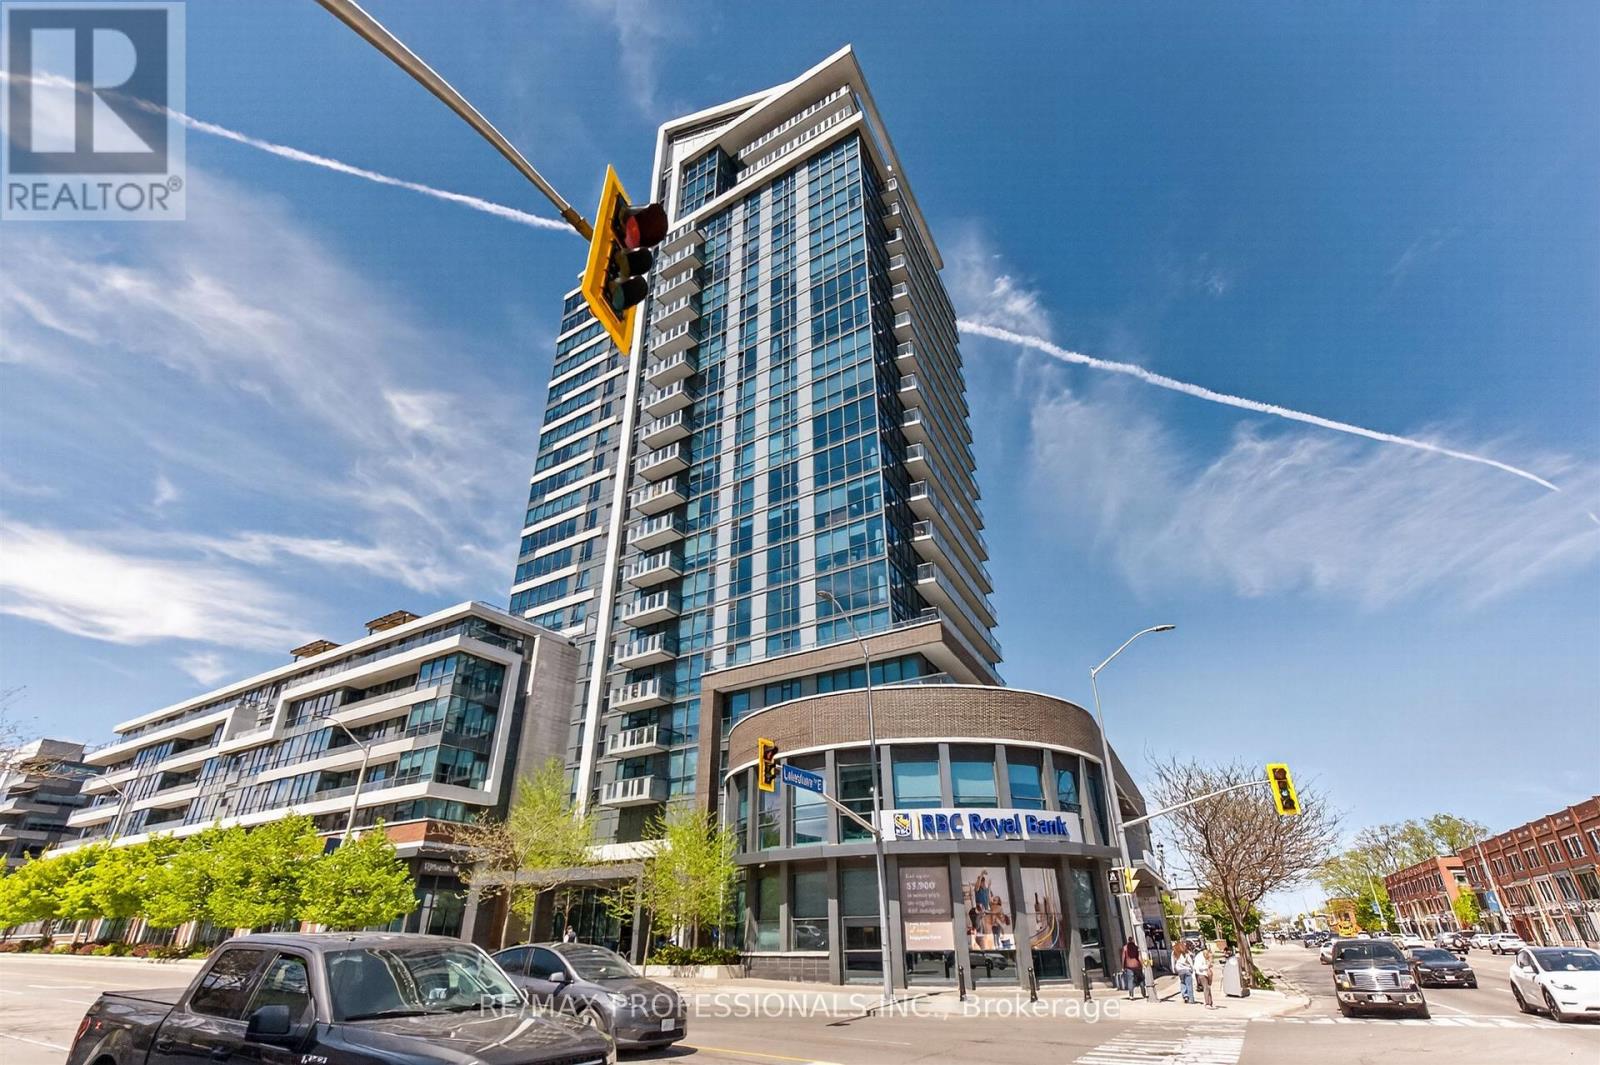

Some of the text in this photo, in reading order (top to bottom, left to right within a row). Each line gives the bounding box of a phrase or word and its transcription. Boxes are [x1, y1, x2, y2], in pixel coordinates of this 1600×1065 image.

[921, 813, 963, 834] RBC
[968, 813, 1021, 839] Royal
[1025, 815, 1069, 836] Bank
